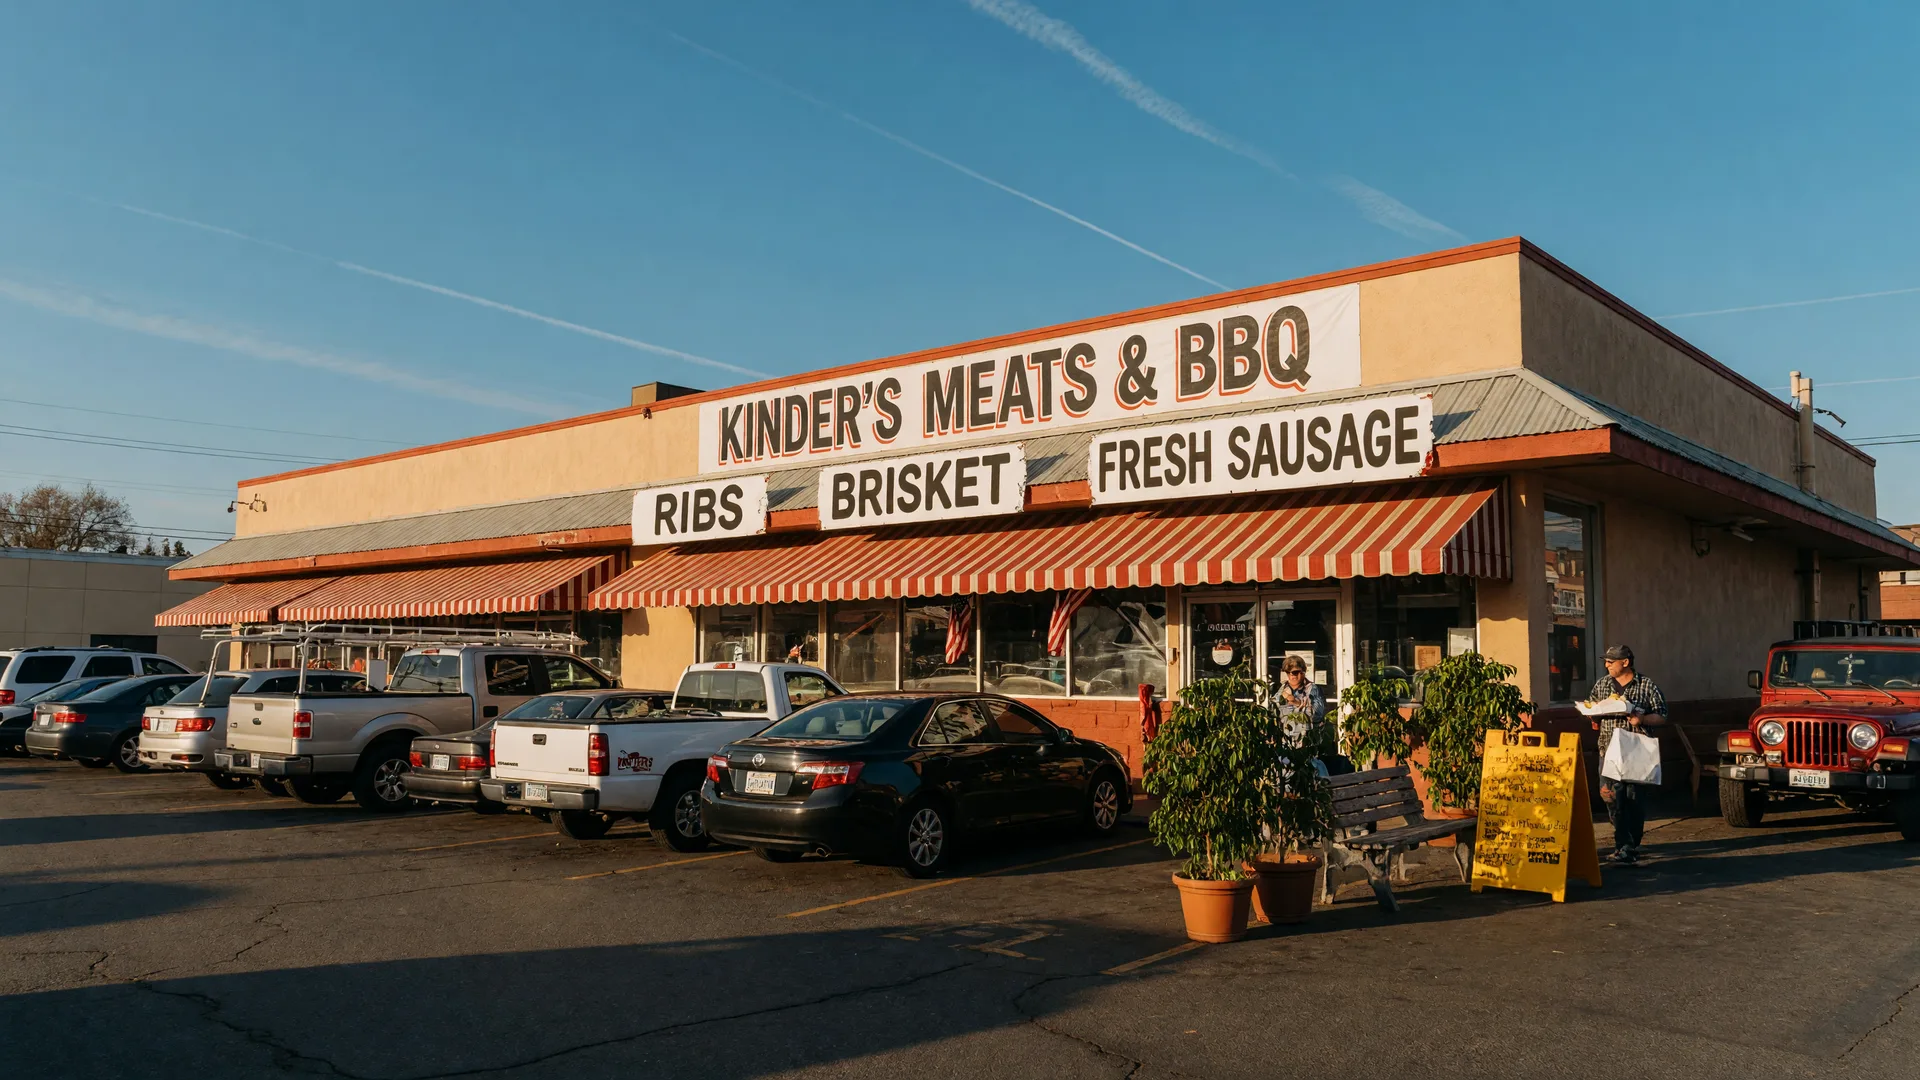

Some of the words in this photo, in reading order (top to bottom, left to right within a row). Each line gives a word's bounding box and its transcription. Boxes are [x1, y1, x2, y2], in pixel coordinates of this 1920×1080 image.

[717, 376, 902, 466] KINDER'S
[922, 341, 1097, 436] MEATS
[1114, 333, 1159, 409] &
[1175, 304, 1312, 402] BBQ
[831, 451, 1011, 520] BRISKET
[1098, 430, 1213, 493] FRESH
[1227, 405, 1421, 480] SAUSAGE
[654, 484, 744, 536] RIBS
